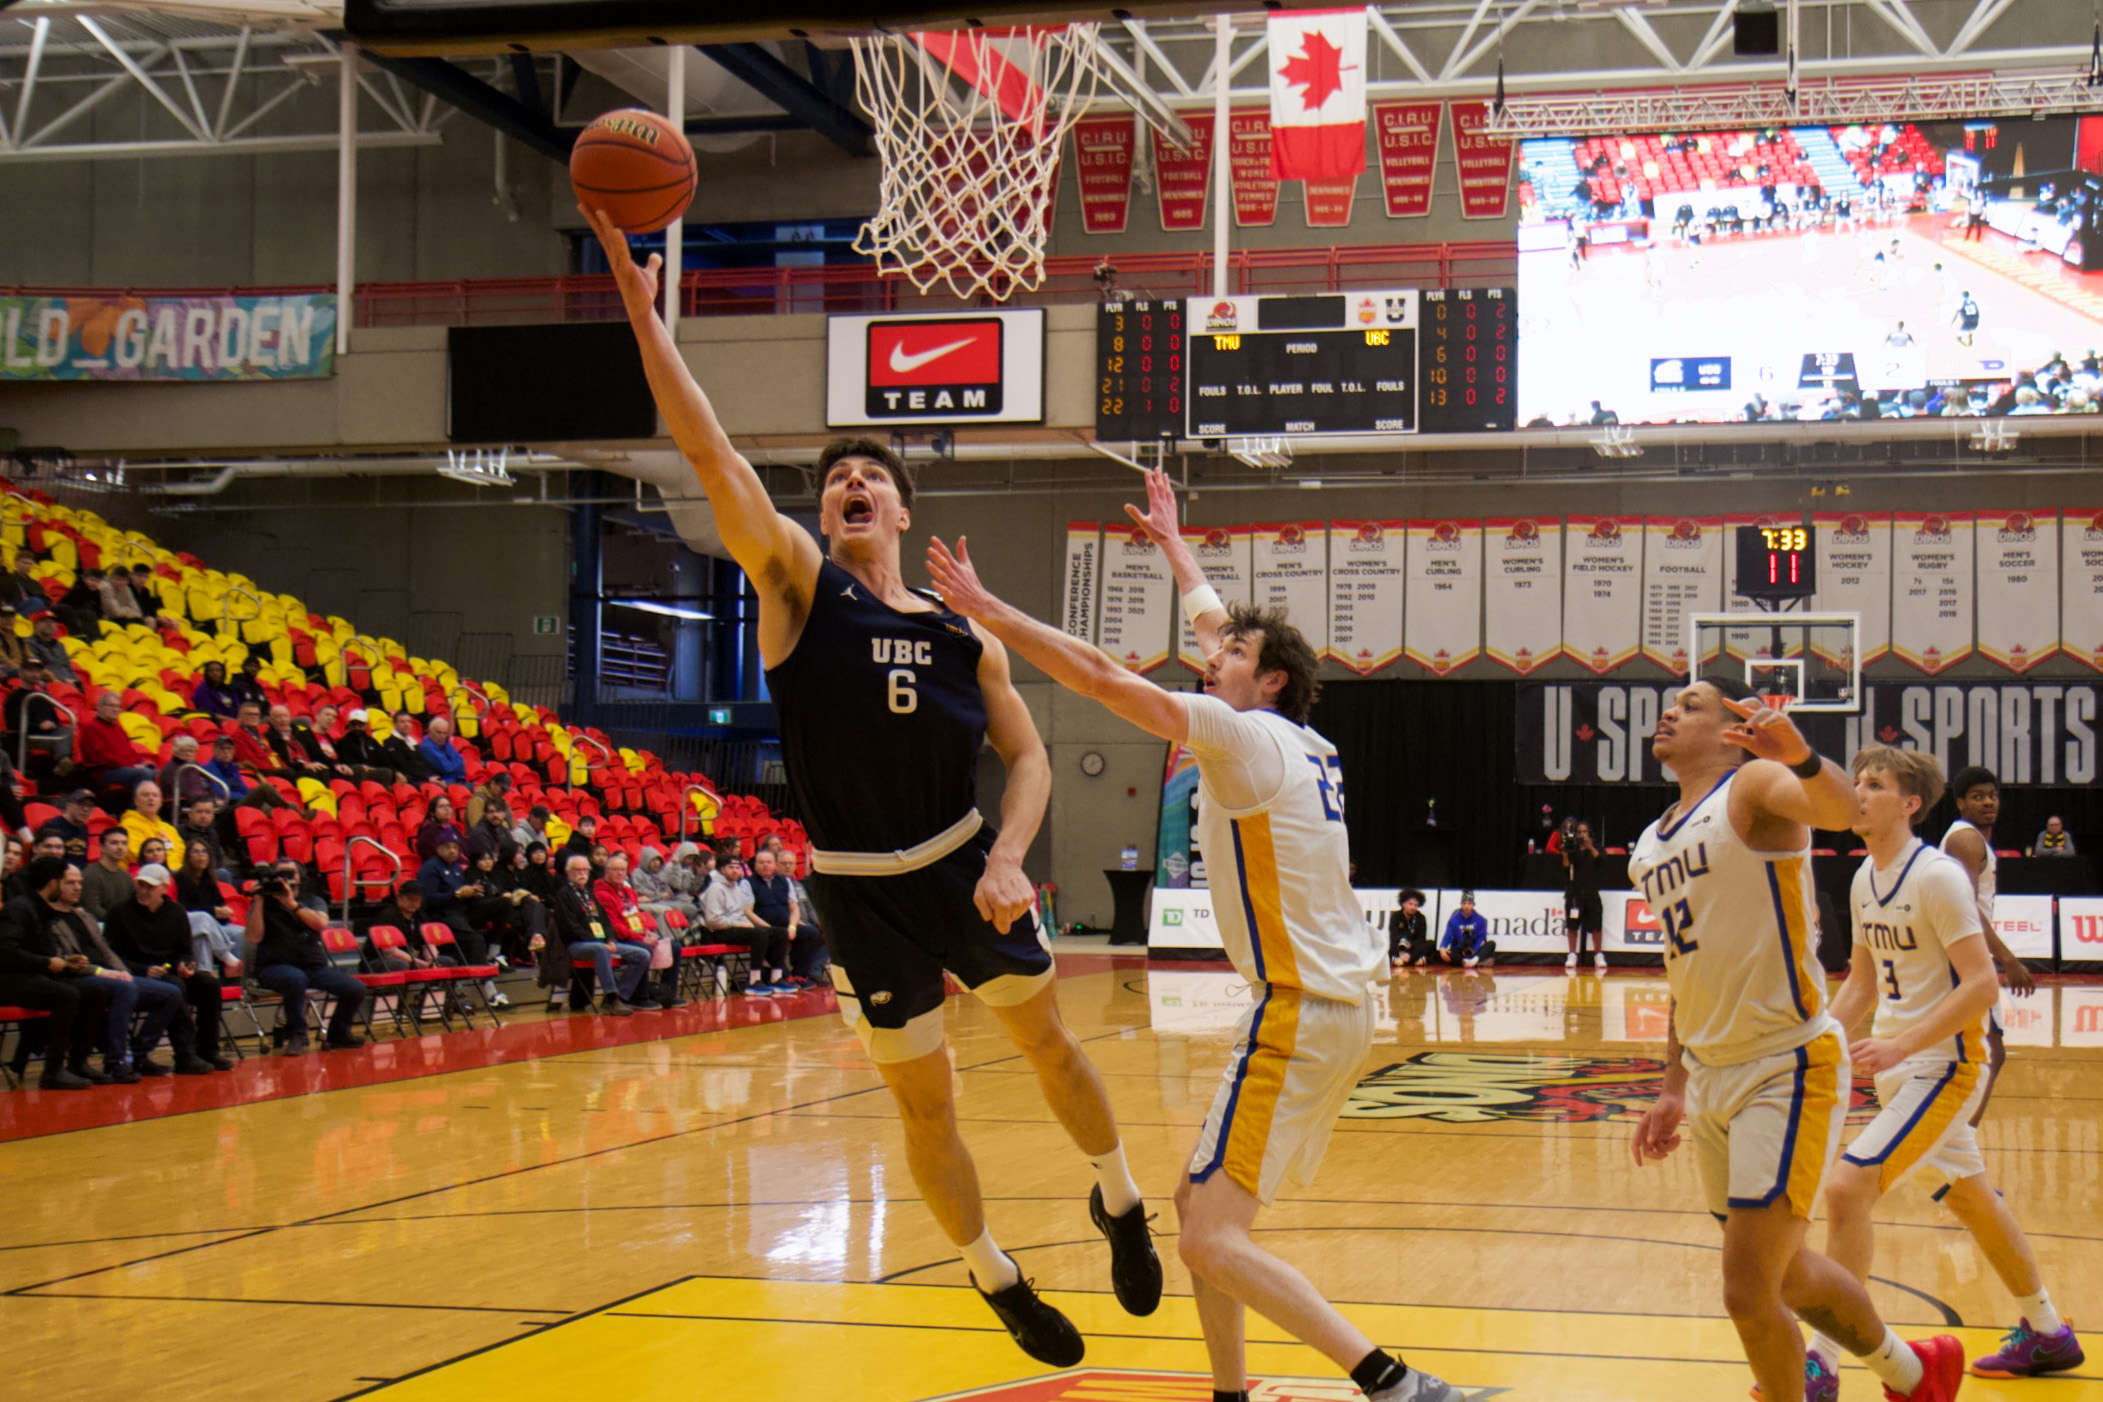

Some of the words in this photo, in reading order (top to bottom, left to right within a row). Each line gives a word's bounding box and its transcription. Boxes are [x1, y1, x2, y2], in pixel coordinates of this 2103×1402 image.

[1426, 291, 1444, 301] PLYR
[1458, 290, 1472, 300] FLS
[1488, 289, 1502, 299] PTS
[1105, 303, 1123, 313] PLYR
[1136, 302, 1149, 312] FLS
[1163, 301, 1177, 311] PTS
[1466, 303, 1476, 320] 0
[1496, 302, 1506, 318] 2
[1114, 316, 1124, 331] 3
[1142, 315, 1152, 330] 0
[1170, 314, 1180, 330] 0
[1365, 330, 1390, 346] UBC
[1466, 324, 1476, 340] 0
[1496, 324, 1506, 340] 2
[1113, 336, 1124, 352] 8
[1142, 335, 1152, 351] 0
[1170, 335, 1180, 350] 0
[1214, 334, 1241, 350] TMU
[1286, 343, 1317, 354] PERIOD
[1437, 346, 1447, 362] 6
[1466, 345, 1476, 362] 0
[1496, 345, 1506, 361] 0
[1107, 357, 1124, 373] 12
[1142, 356, 1151, 372] 0
[1170, 355, 1180, 371] 0
[1431, 368, 1447, 384] 10
[1466, 367, 1476, 383] 0
[1496, 366, 1506, 382] 0
[1142, 377, 1151, 392] 0
[1170, 376, 1180, 392] 2
[1199, 387, 1226, 396] FOULS
[1269, 384, 1303, 394] PLAYER
[1311, 383, 1333, 393] FOUL
[1376, 382, 1404, 392] FOULS
[884, 390, 986, 410] TEAM
[1431, 389, 1447, 405] 13
[1466, 388, 1476, 404] 0
[1496, 387, 1506, 404] 2
[1102, 399, 1124, 414] 22
[1170, 397, 1180, 413] 0
[1199, 424, 1226, 434] SCORE
[1286, 422, 1315, 432] MATCH
[1375, 420, 1403, 430] SCORE
[1505, 539, 1541, 550] DINOS
[1586, 537, 1623, 548] DINOS
[1761, 528, 1807, 551] 7:33
[1832, 533, 1870, 545] DINOS
[1829, 553, 1872, 561] WOMEN'S
[1911, 553, 1955, 561] WOMEN'S
[2003, 551, 2031, 559] MEN'S
[1332, 568, 1360, 576] CROSS
[1361, 568, 1401, 576] COUNTRY
[1425, 568, 1462, 576] CURLING
[1504, 566, 1541, 574] CURLING
[1598, 564, 1634, 572] HOCKEY
[1660, 566, 1707, 574] FOOTBALL
[1769, 552, 1799, 584] 11
[1999, 560, 2036, 568] SOCCER
[1111, 571, 1164, 580] BASKETBALL
[1256, 571, 1283, 579] CROSS
[1285, 569, 1323, 578] COUNTRY
[1841, 577, 1860, 585] 2012
[2007, 575, 2028, 583] 1980
[1068, 553, 1082, 636] CONFERENCE
[871, 637, 932, 665] UBC
[887, 669, 918, 714] 6
[1901, 686, 2096, 784] SPORTS
[1641, 840, 1710, 903] TMU
[1163, 910, 1182, 925] TD
[1194, 908, 1210, 919] TD
[1486, 908, 1567, 937] nada
[1662, 897, 1699, 960] 12
[1863, 922, 1918, 951] TMU
[1882, 959, 1902, 1001] 3
